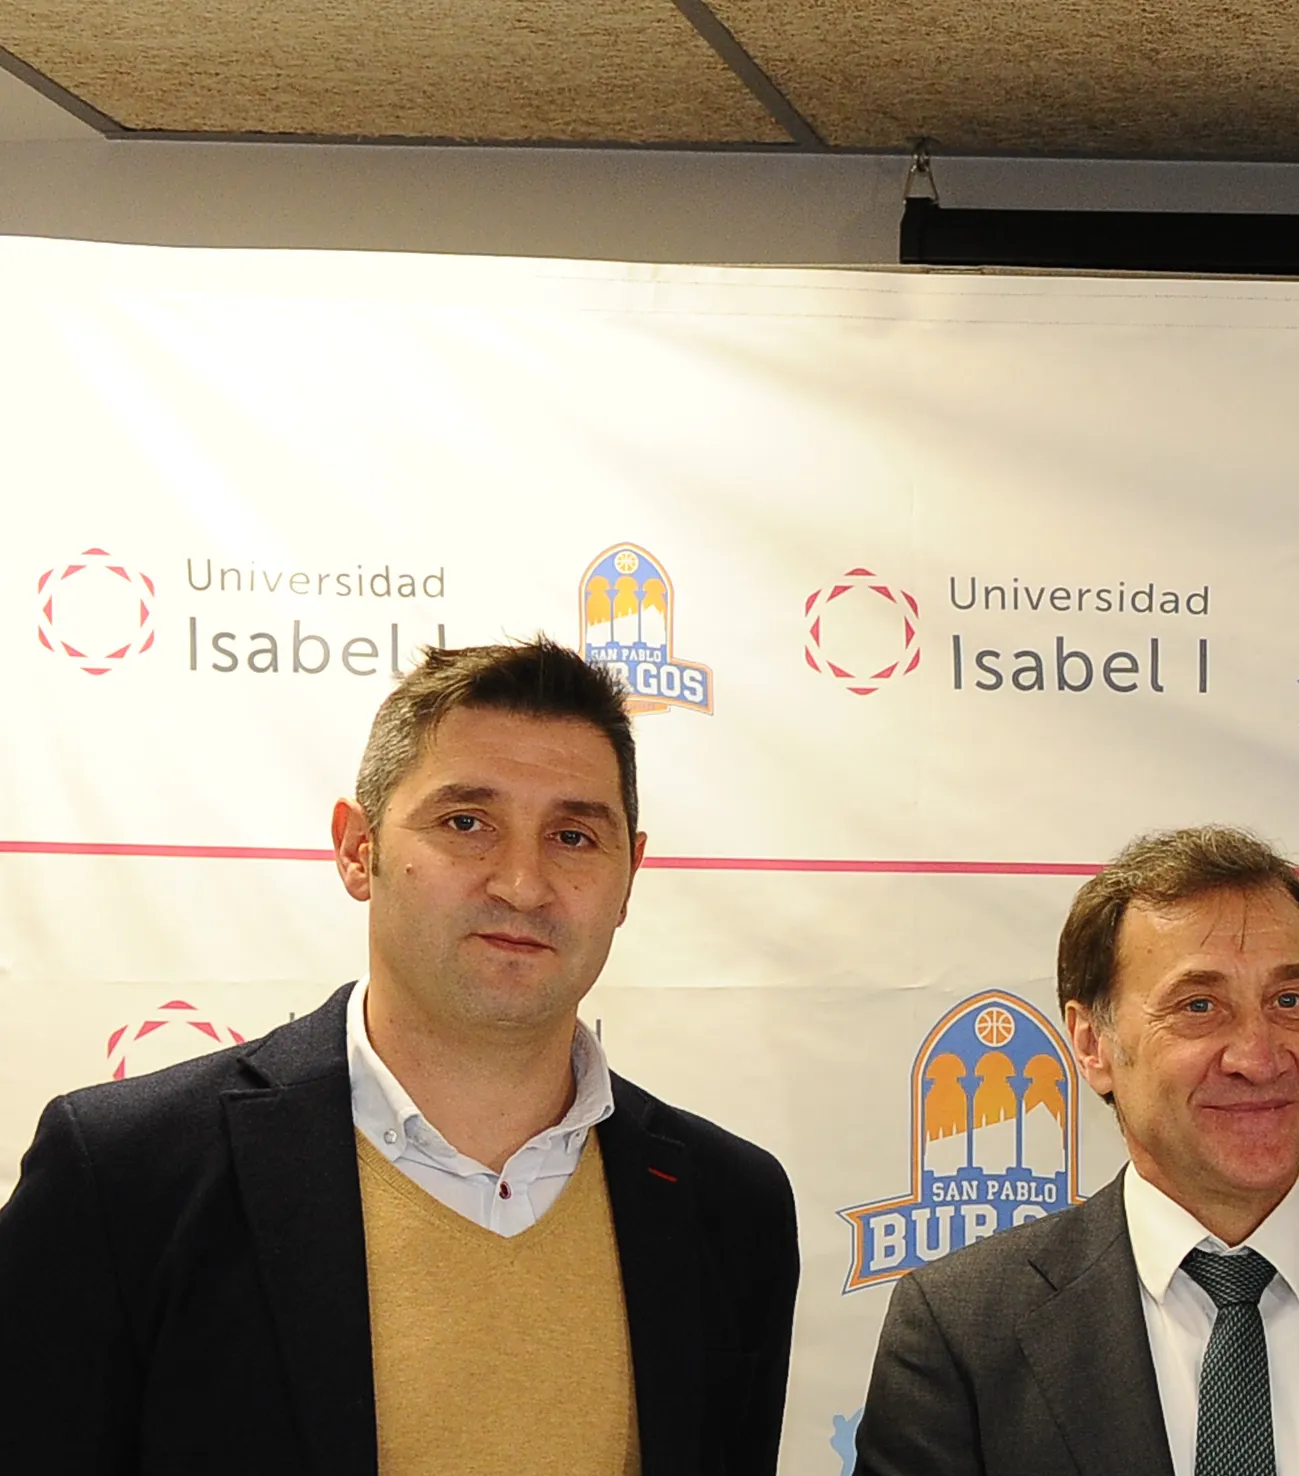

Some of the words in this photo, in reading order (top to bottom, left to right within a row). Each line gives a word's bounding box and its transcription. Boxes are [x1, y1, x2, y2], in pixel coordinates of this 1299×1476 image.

[187, 558, 446, 599] Universidad
[949, 576, 1210, 616] Universidad
[188, 616, 406, 677] Isabel
[591, 648, 617, 661] SAN
[621, 648, 661, 662] PABLO
[952, 634, 1164, 693] Isabel
[1199, 637, 1209, 694] I
[607, 661, 704, 702] RGOS
[932, 1180, 978, 1202] SAN
[986, 1180, 1057, 1202] PABLO
